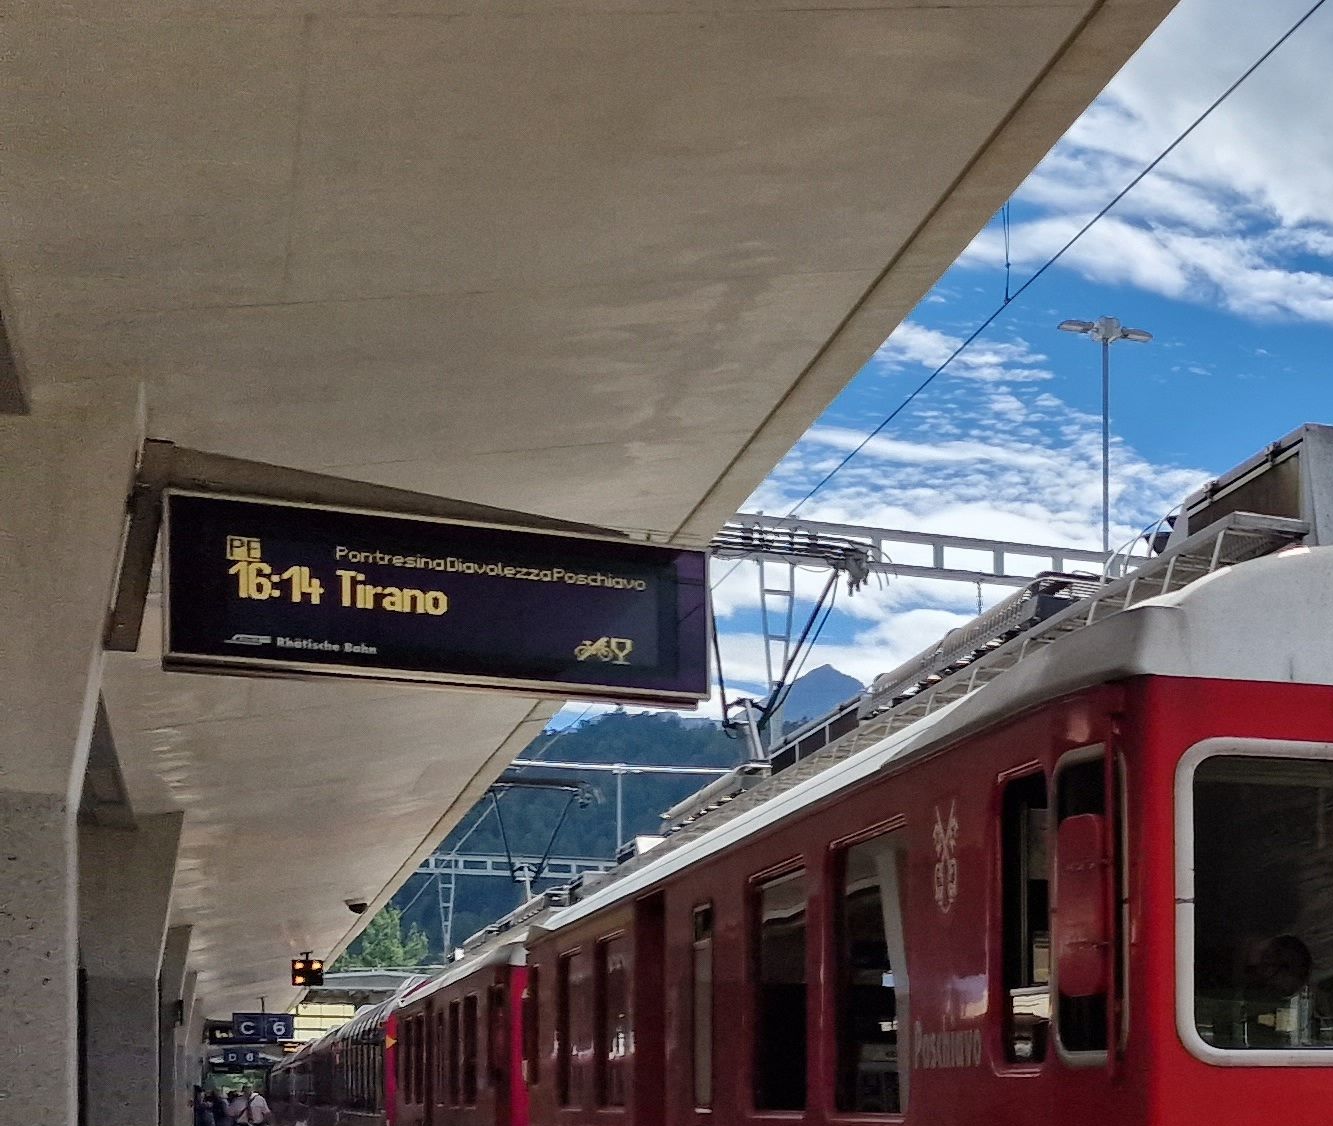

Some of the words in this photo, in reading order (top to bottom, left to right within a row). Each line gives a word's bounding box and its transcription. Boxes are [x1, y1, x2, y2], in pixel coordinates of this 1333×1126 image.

[228, 562, 325, 605] 16:14
[335, 569, 449, 616] Tirano
[343, 642, 378, 655] Bahn
[241, 1022, 255, 1035] C
[273, 1022, 285, 1035] 6
[229, 1053, 236, 1061] D
